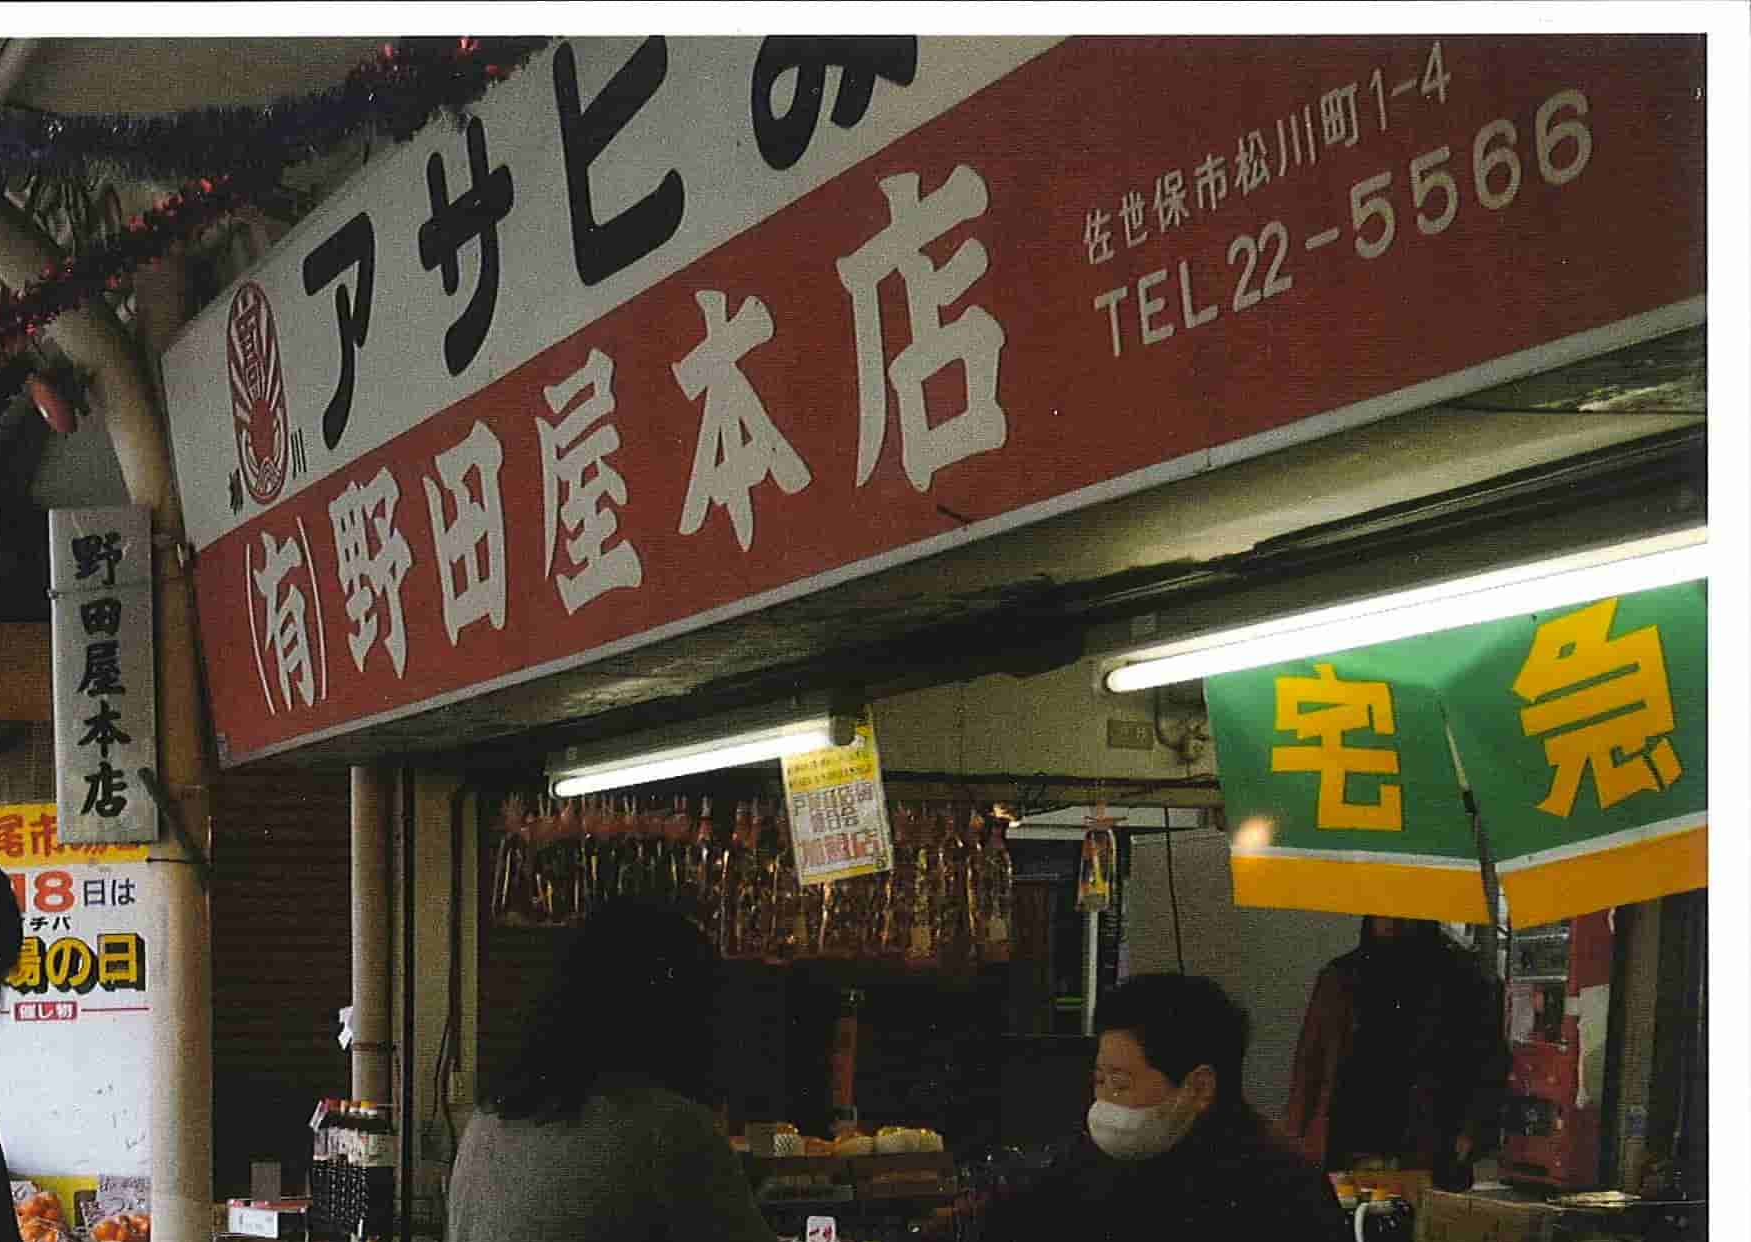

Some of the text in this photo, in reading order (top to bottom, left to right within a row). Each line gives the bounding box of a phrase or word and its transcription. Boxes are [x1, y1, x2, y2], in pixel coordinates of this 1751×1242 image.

[1082, 40, 1451, 265] 佐世保市松川町1-4
[1094, 89, 1593, 356] TEL 22-5566
[70, 532, 132, 818] 野田屋本店
